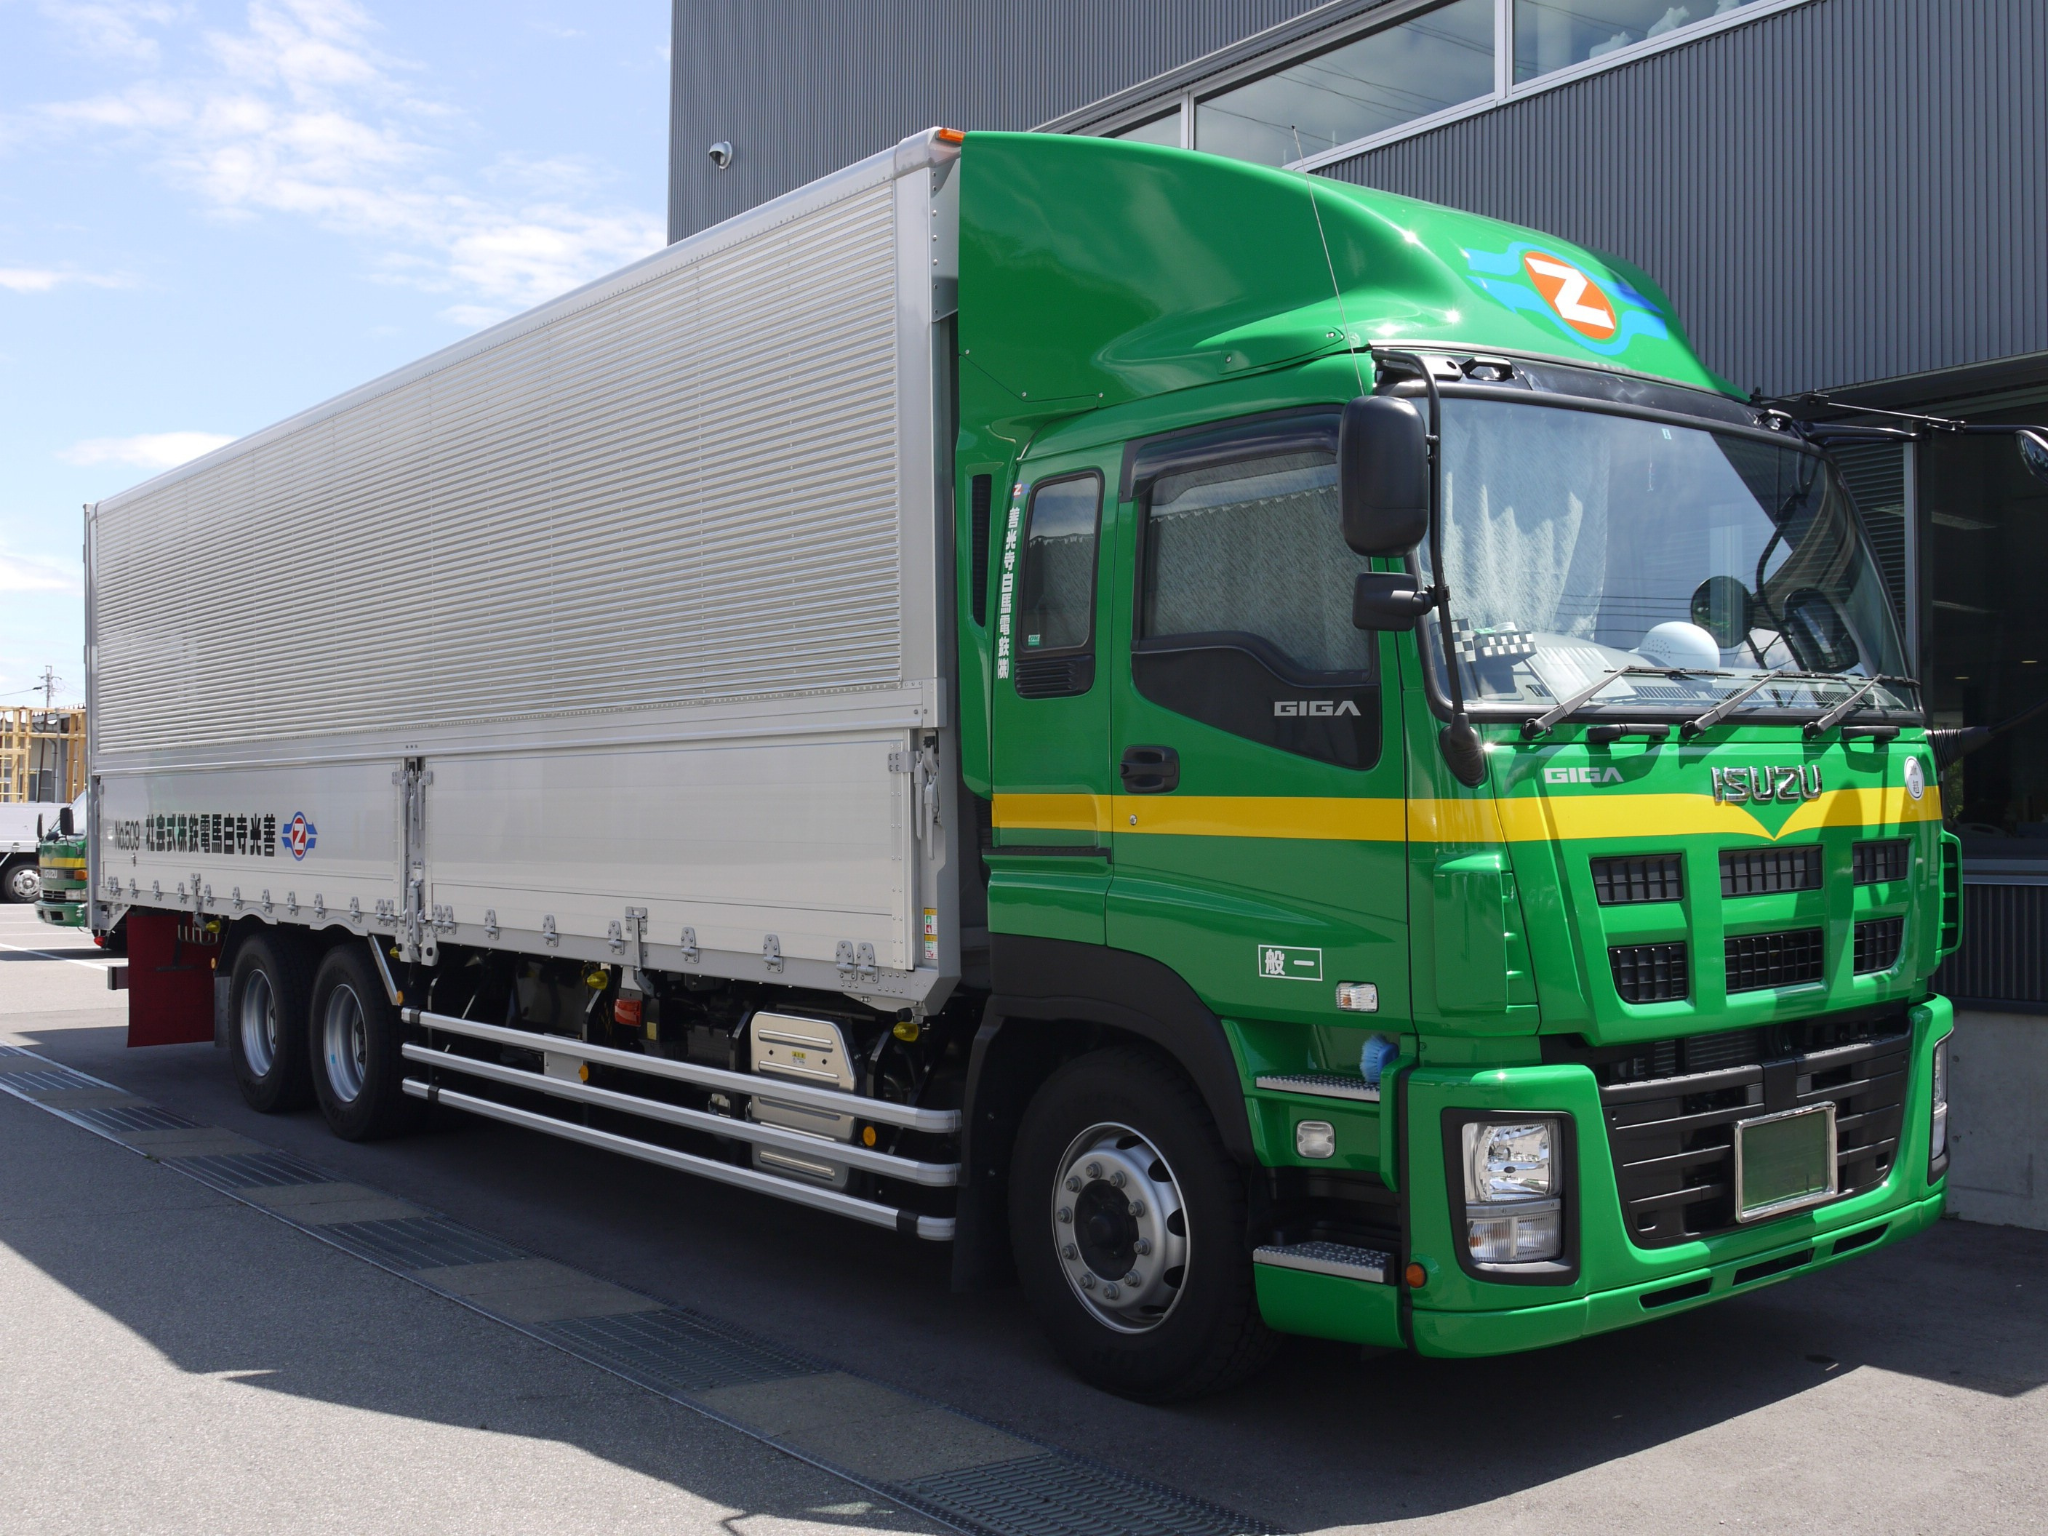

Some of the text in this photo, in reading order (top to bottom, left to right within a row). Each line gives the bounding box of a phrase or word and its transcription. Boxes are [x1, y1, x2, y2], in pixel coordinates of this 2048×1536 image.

[1274, 700, 1361, 716] GIGA
[1544, 767, 1624, 784] GIGA
[1711, 764, 1824, 803] ISUZU
